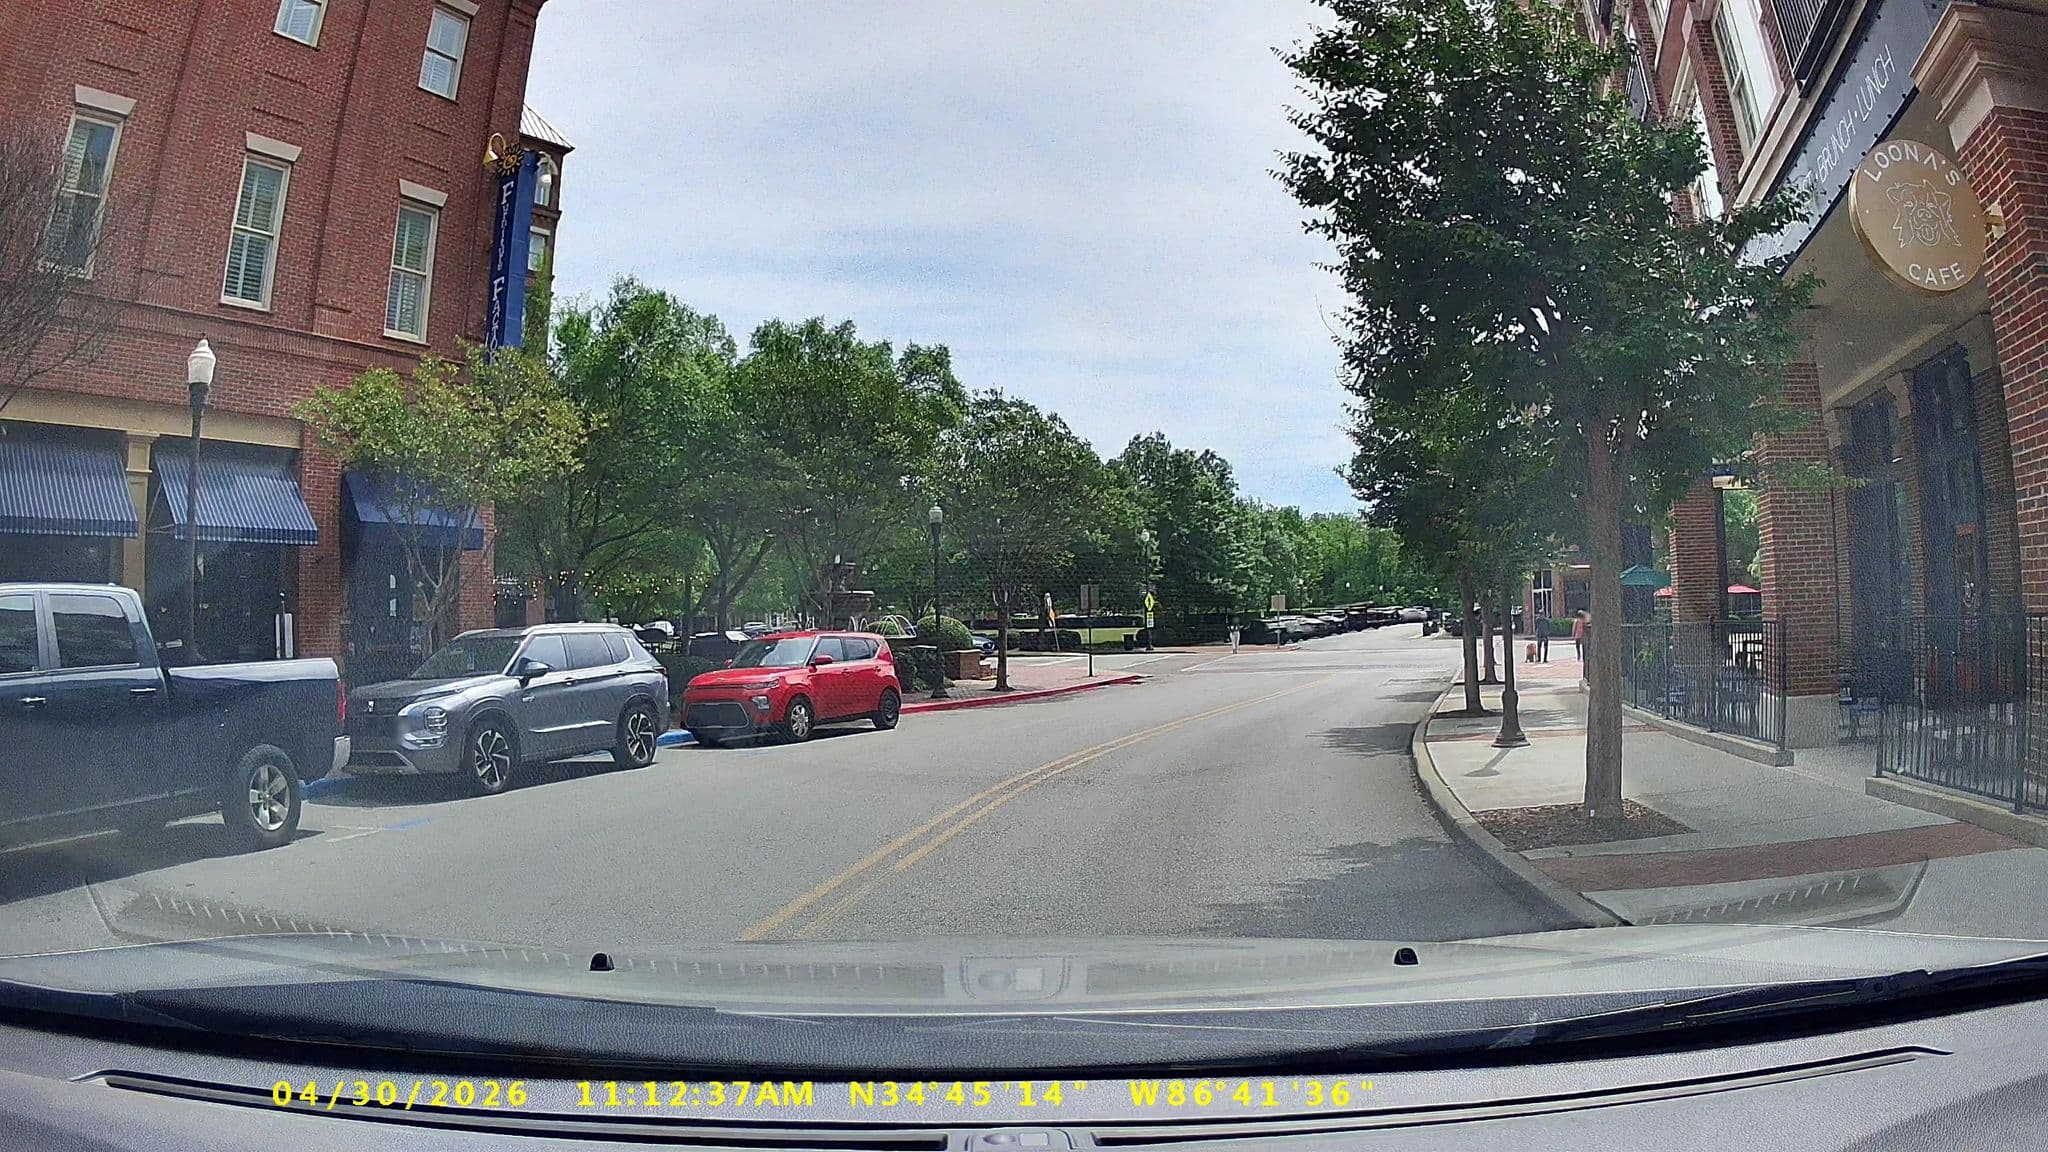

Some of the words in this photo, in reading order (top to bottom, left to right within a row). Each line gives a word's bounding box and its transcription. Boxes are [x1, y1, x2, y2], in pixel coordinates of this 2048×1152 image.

[1816, 109, 1856, 184] BRUNCH
[1855, 43, 1896, 122] LUNCH
[1908, 262, 1966, 286] CAFE
